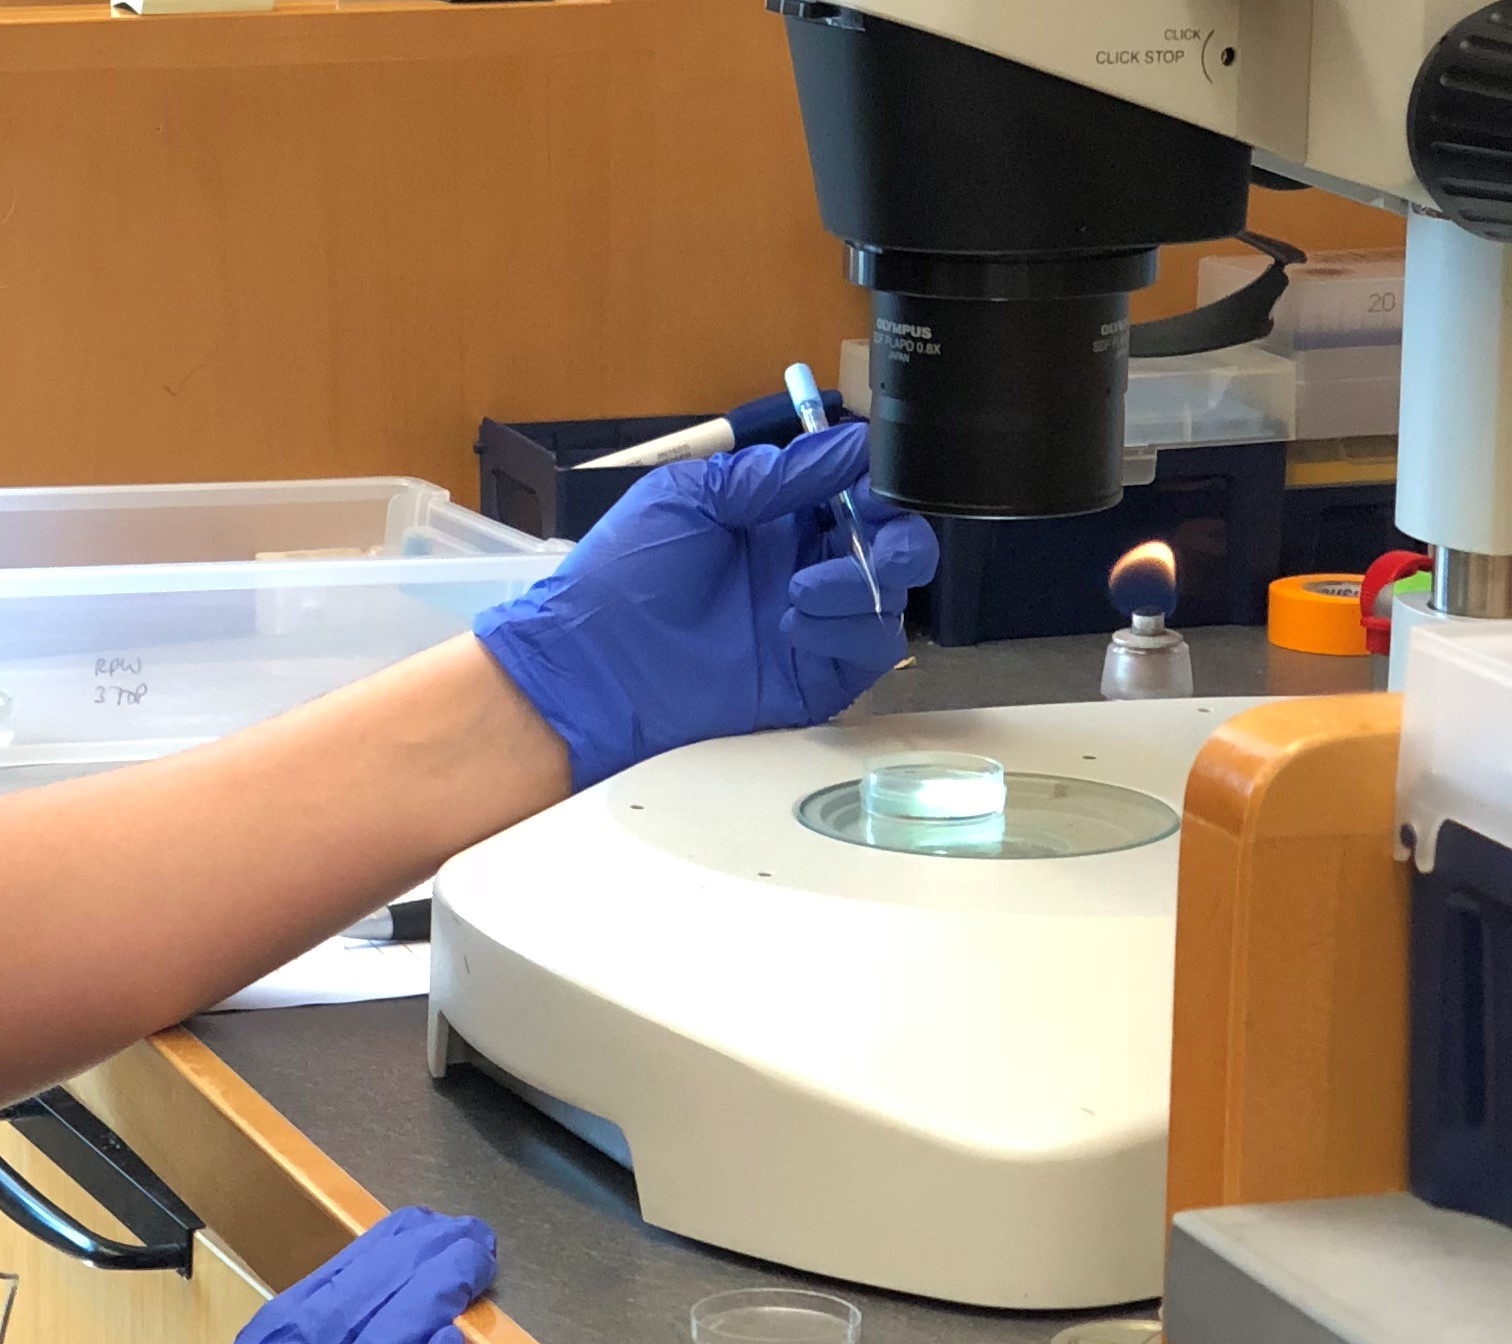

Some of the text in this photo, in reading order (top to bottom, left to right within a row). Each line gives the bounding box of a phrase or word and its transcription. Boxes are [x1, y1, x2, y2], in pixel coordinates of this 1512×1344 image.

[1164, 28, 1202, 41] CLICK
[1095, 49, 1185, 65] CLICK STOP
[876, 317, 933, 340] OLYMPUS
